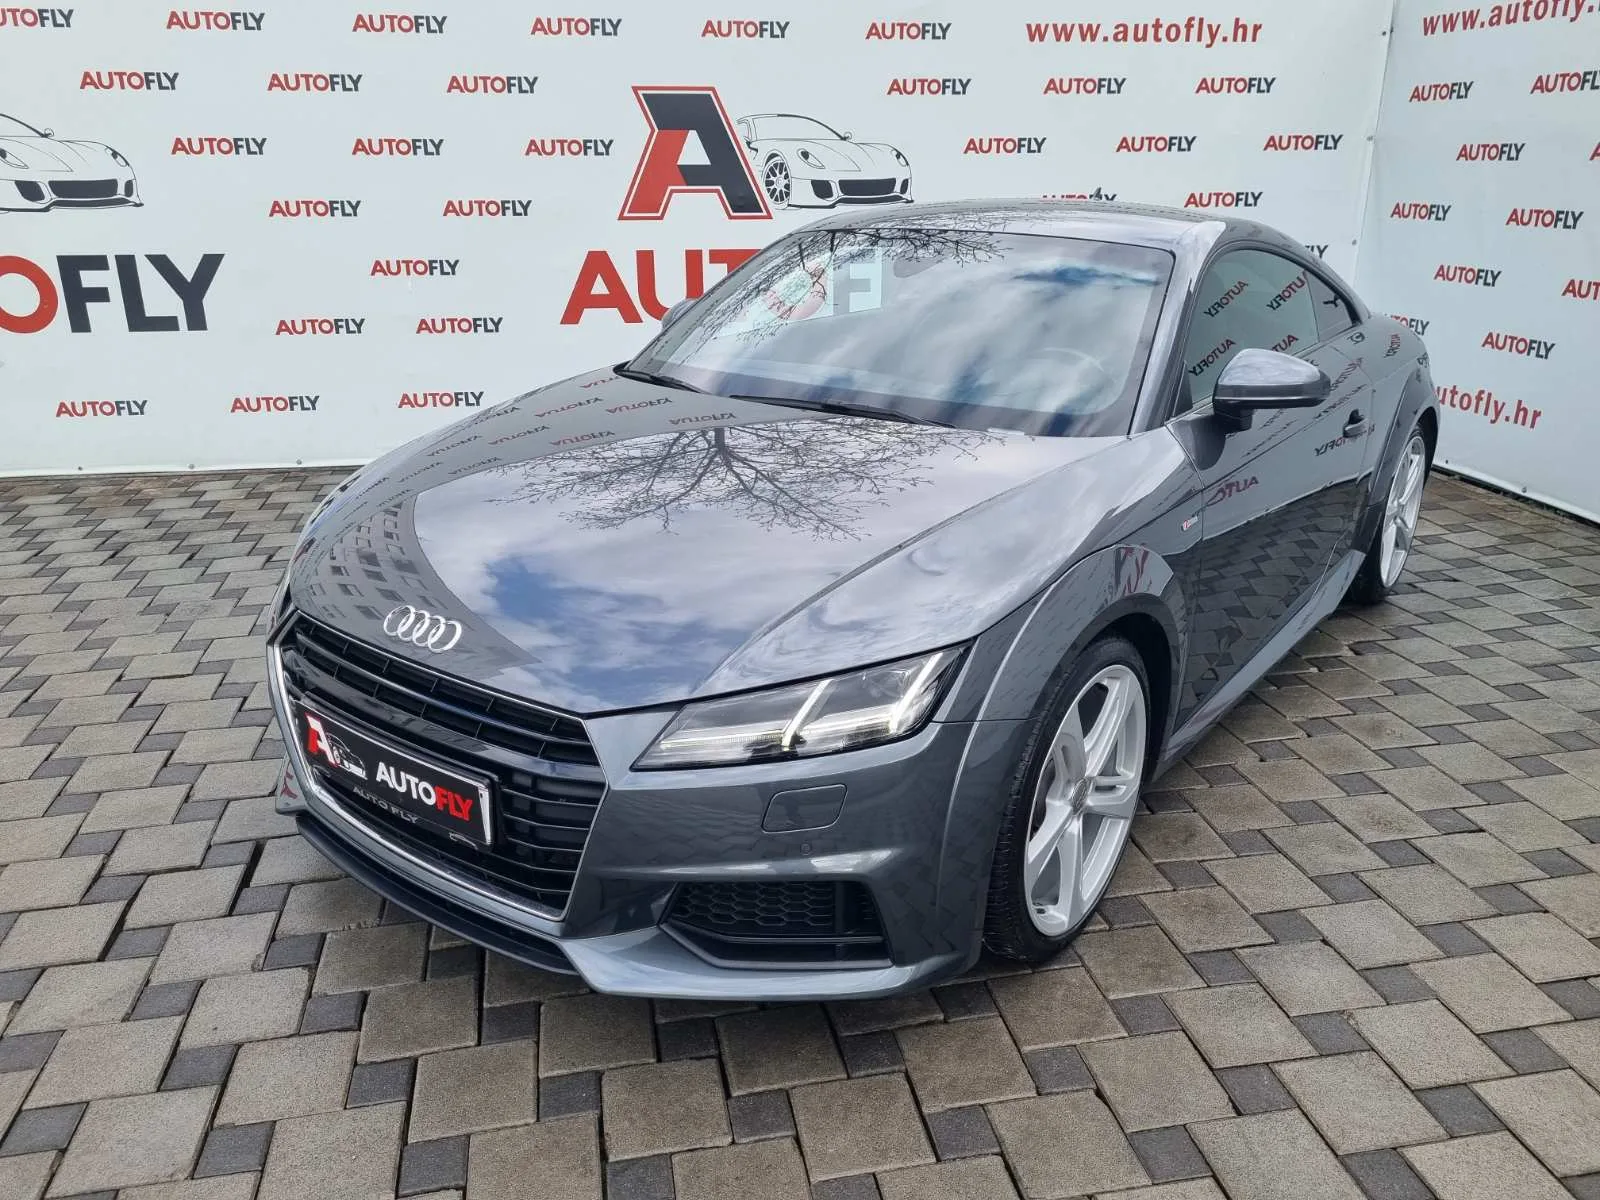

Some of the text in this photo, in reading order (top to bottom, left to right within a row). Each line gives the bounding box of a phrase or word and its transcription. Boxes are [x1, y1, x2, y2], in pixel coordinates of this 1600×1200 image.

[167, 11, 265, 30] AUTOFLY
[353, 14, 447, 33] AUTOFLY
[1423, 0, 1600, 36] www.autofly.
[531, 18, 622, 36] AUTOFLY
[702, 20, 790, 38] AUTOFLY
[866, 23, 952, 40] AUTOFLY
[1026, 17, 1262, 48] www.autofly.hr
[80, 72, 179, 90] AUTOFLY
[268, 74, 362, 91] AUTOFLY
[447, 76, 538, 94] AUTOFLY
[887, 79, 971, 95] AUTOFLY
[1044, 78, 1126, 94] AUTOFLY
[1195, 77, 1276, 93] AUTOFLY
[1409, 81, 1474, 102] AUTOFLY
[172, 138, 267, 155] AUTOFLY
[352, 139, 444, 156] AUTOFLY
[525, 139, 614, 156] AUTOFLY
[964, 137, 1046, 154] AUTOFLY
[1116, 136, 1197, 152] AUTOFLY
[1264, 134, 1343, 151] AUTOFLY
[1456, 143, 1526, 161] AUTOFLY
[443, 200, 532, 216] AUTOFLY
[1184, 192, 1263, 207] AUTOFLY
[269, 200, 361, 217] AUTOFLY
[1390, 202, 1452, 221] AUTOFLY
[1505, 208, 1584, 230] AUTOFLY
[371, 260, 459, 276] AUTOFLY
[1434, 265, 1502, 287] AUTOFLY
[276, 318, 365, 335] AUTOFLY
[416, 317, 503, 334] AUTOFLY
[1481, 332, 1556, 360] AUTOFLY
[56, 400, 147, 417] AUTOFLY
[231, 395, 319, 413] AUTOFLY
[398, 392, 484, 409] AUTOFLY
[1435, 385, 1542, 429] utofly.hr
[376, 761, 473, 822] AUTOFLY
[353, 786, 419, 824] AUTO FLY
